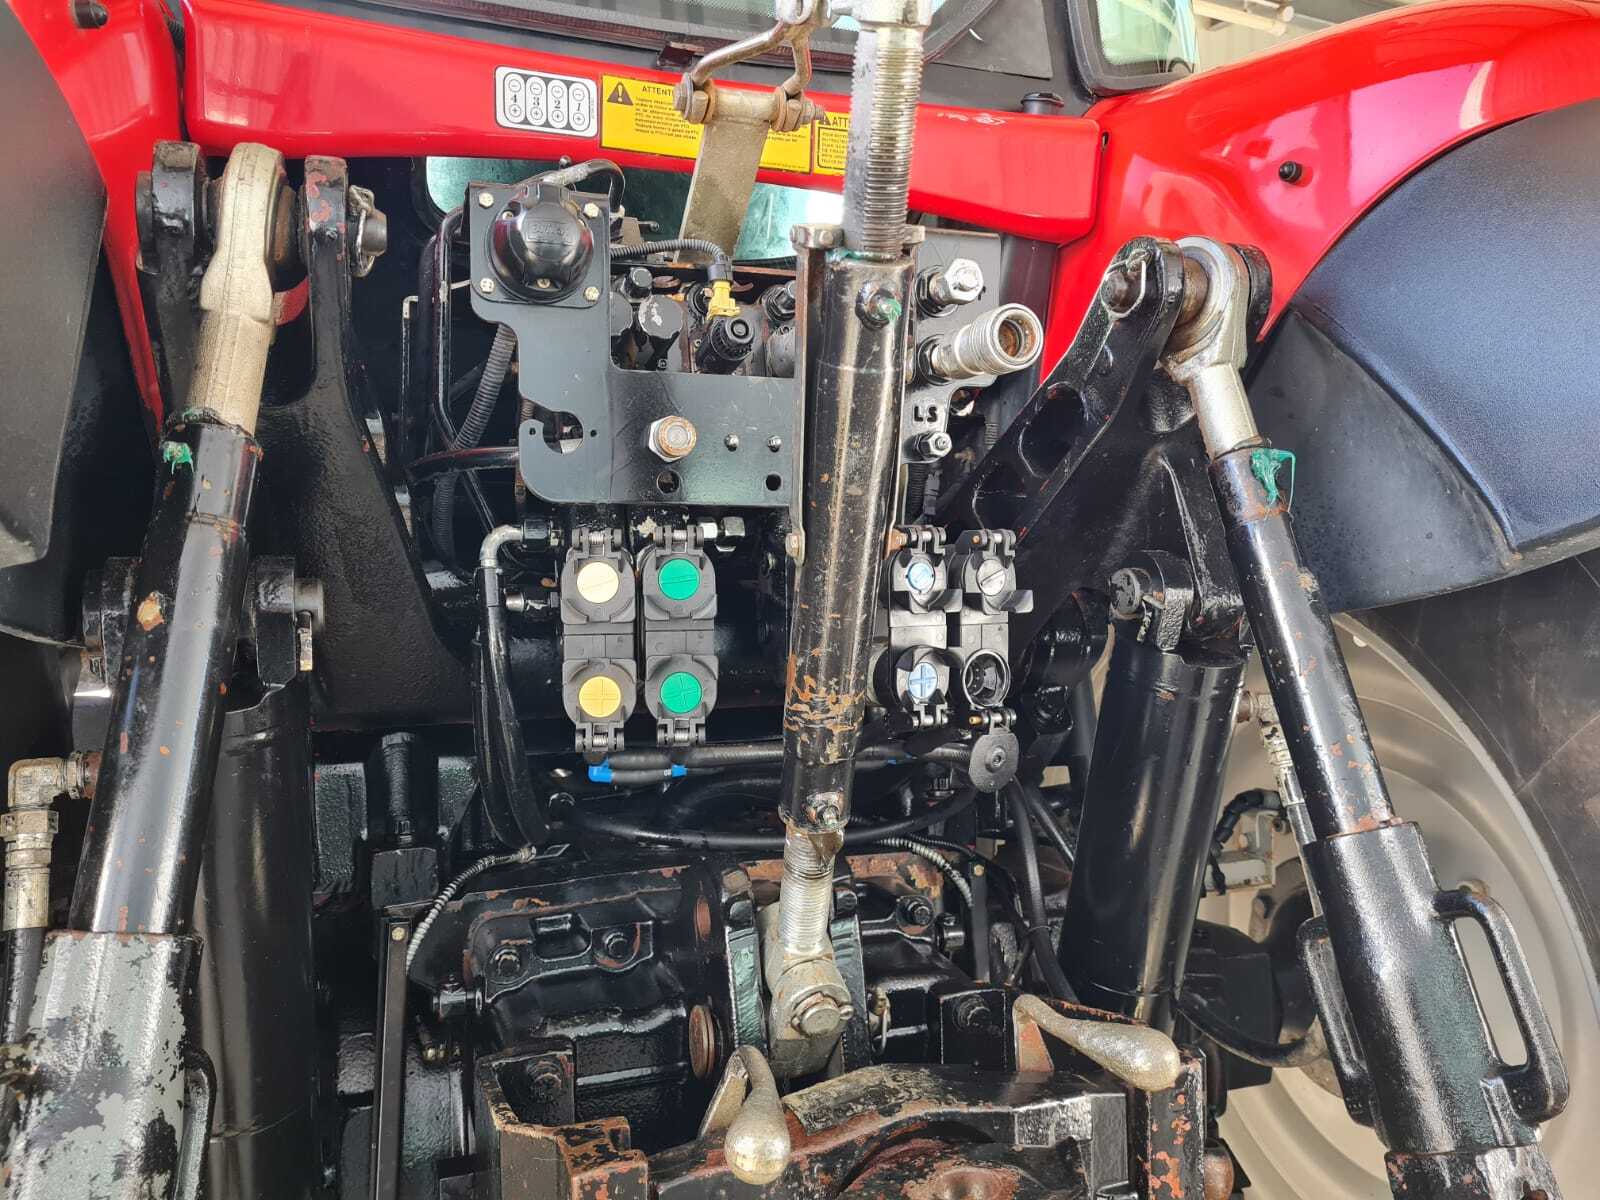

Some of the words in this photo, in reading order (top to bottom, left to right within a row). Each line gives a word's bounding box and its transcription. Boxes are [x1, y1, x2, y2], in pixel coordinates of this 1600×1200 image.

[641, 85, 674, 98] ATTENT
[510, 93, 518, 104] 4
[554, 99, 561, 109] 2
[832, 116, 849, 127] ATT
[914, 406, 937, 422] LS
